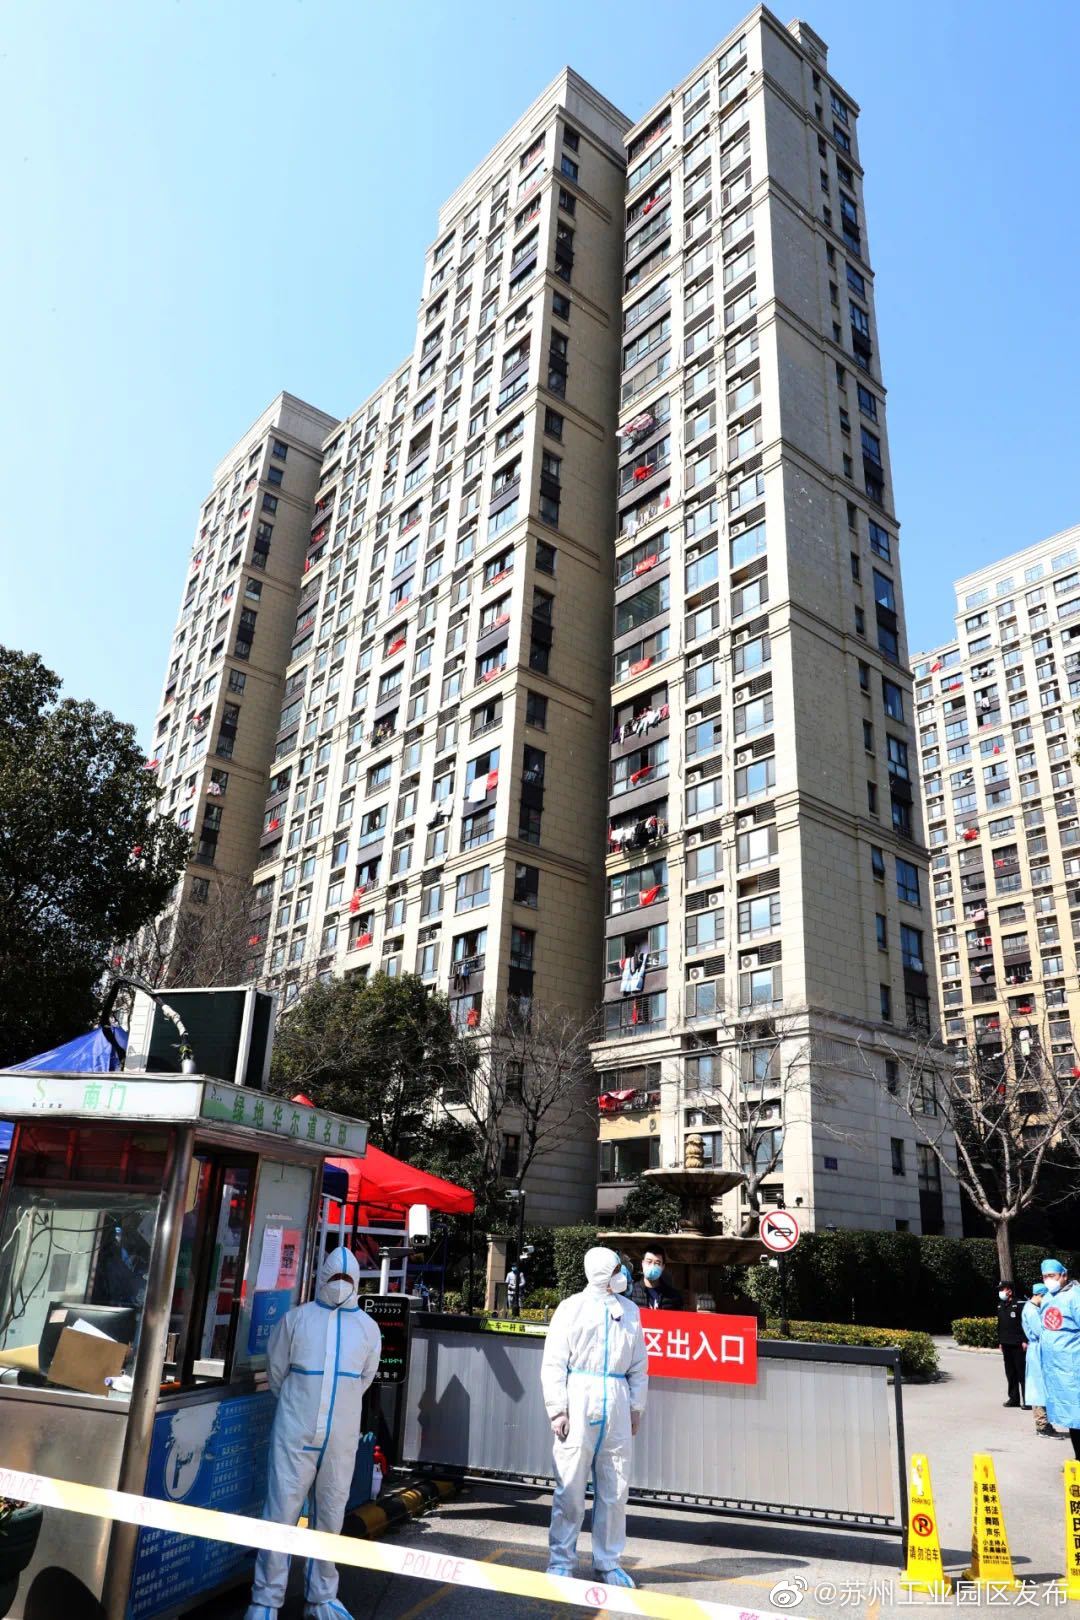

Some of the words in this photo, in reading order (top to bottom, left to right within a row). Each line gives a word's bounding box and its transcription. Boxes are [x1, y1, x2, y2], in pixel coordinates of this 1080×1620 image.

[82, 1082, 128, 1112] 南门
[642, 1327, 745, 1365] 区出入口
[982, 1483, 997, 1493] 英语
[984, 1505, 999, 1516] 书法
[986, 1527, 1001, 1538] 声乐
[909, 1545, 939, 1562] 请勿泊车
[402, 1550, 465, 1582] POLICE
